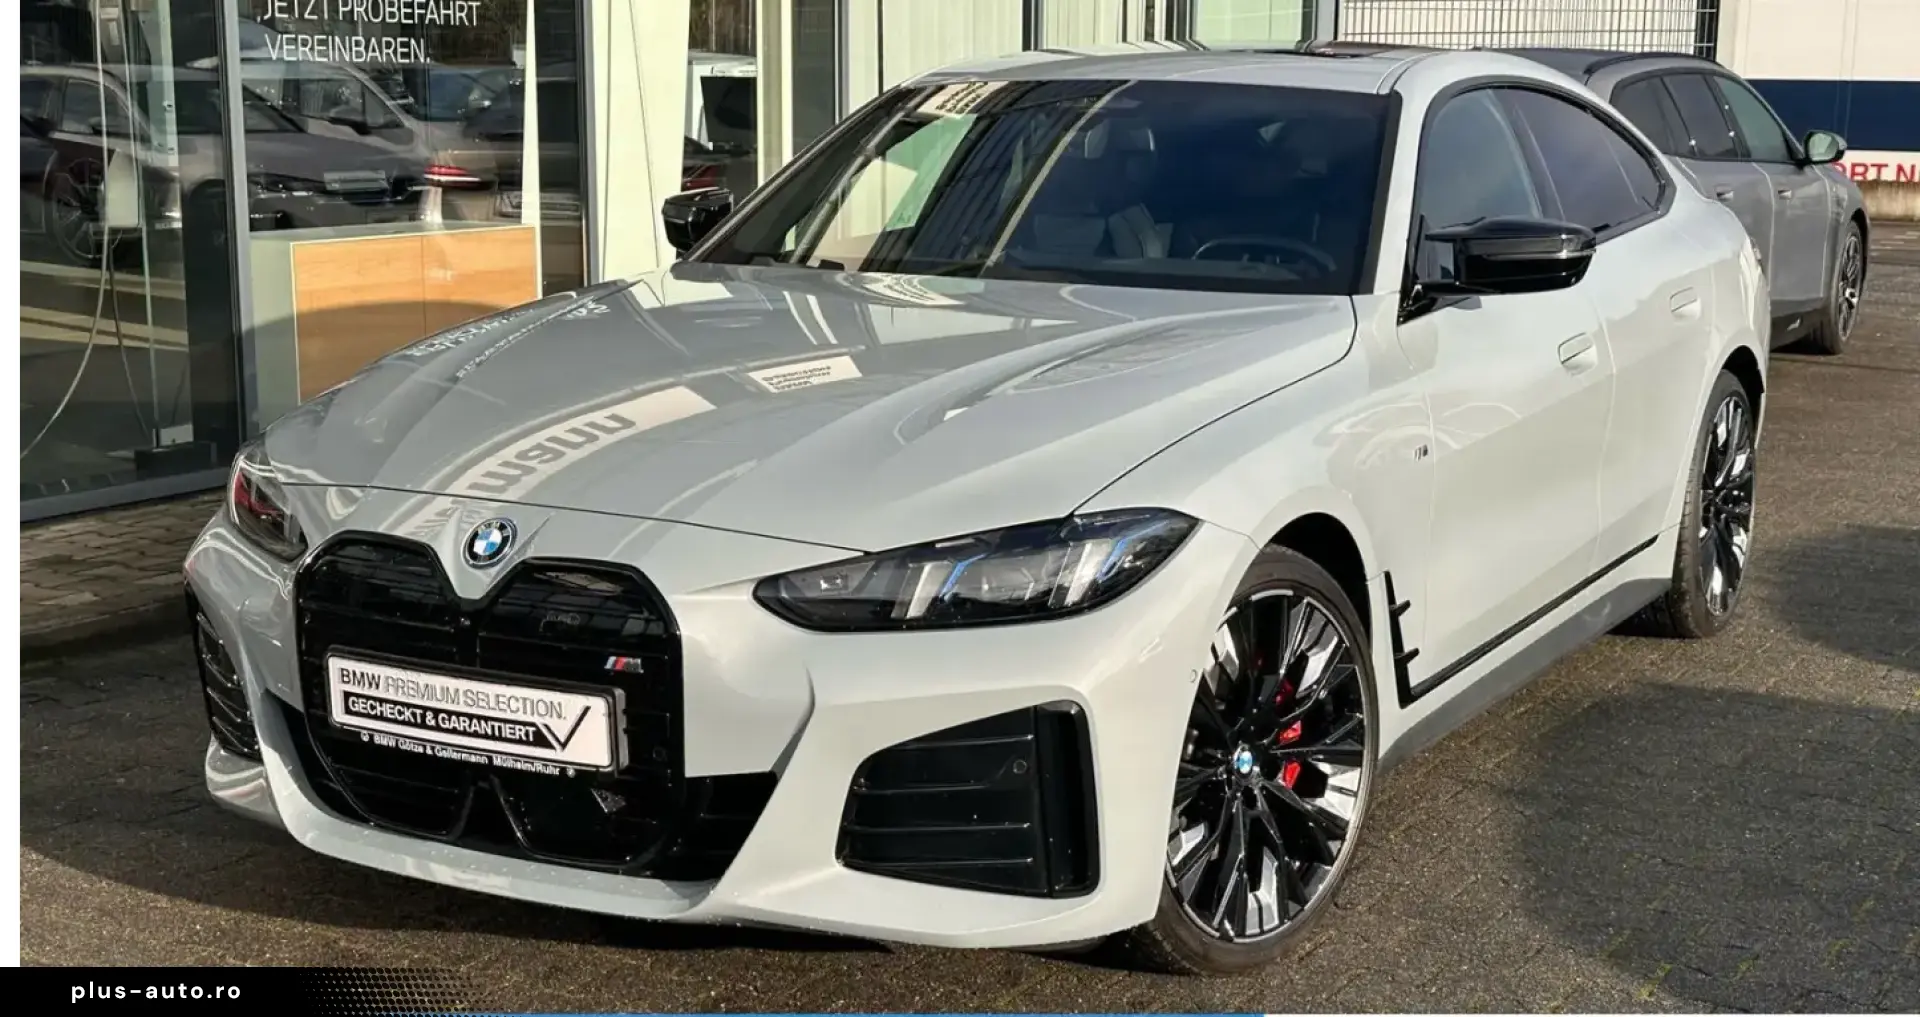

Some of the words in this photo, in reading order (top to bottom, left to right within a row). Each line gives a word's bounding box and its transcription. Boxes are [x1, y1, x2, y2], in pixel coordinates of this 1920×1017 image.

[338, 0, 482, 27] PROBEFAHRT
[264, 33, 431, 64] VEREINBAREN.
[340, 667, 381, 690] BMW
[384, 675, 460, 706] PREMIUM
[462, 688, 567, 720] SELECTION.
[348, 696, 423, 724] GECHECKT
[425, 711, 436, 726] &
[438, 712, 536, 742] GARANTIERT
[373, 732, 396, 748] BMW
